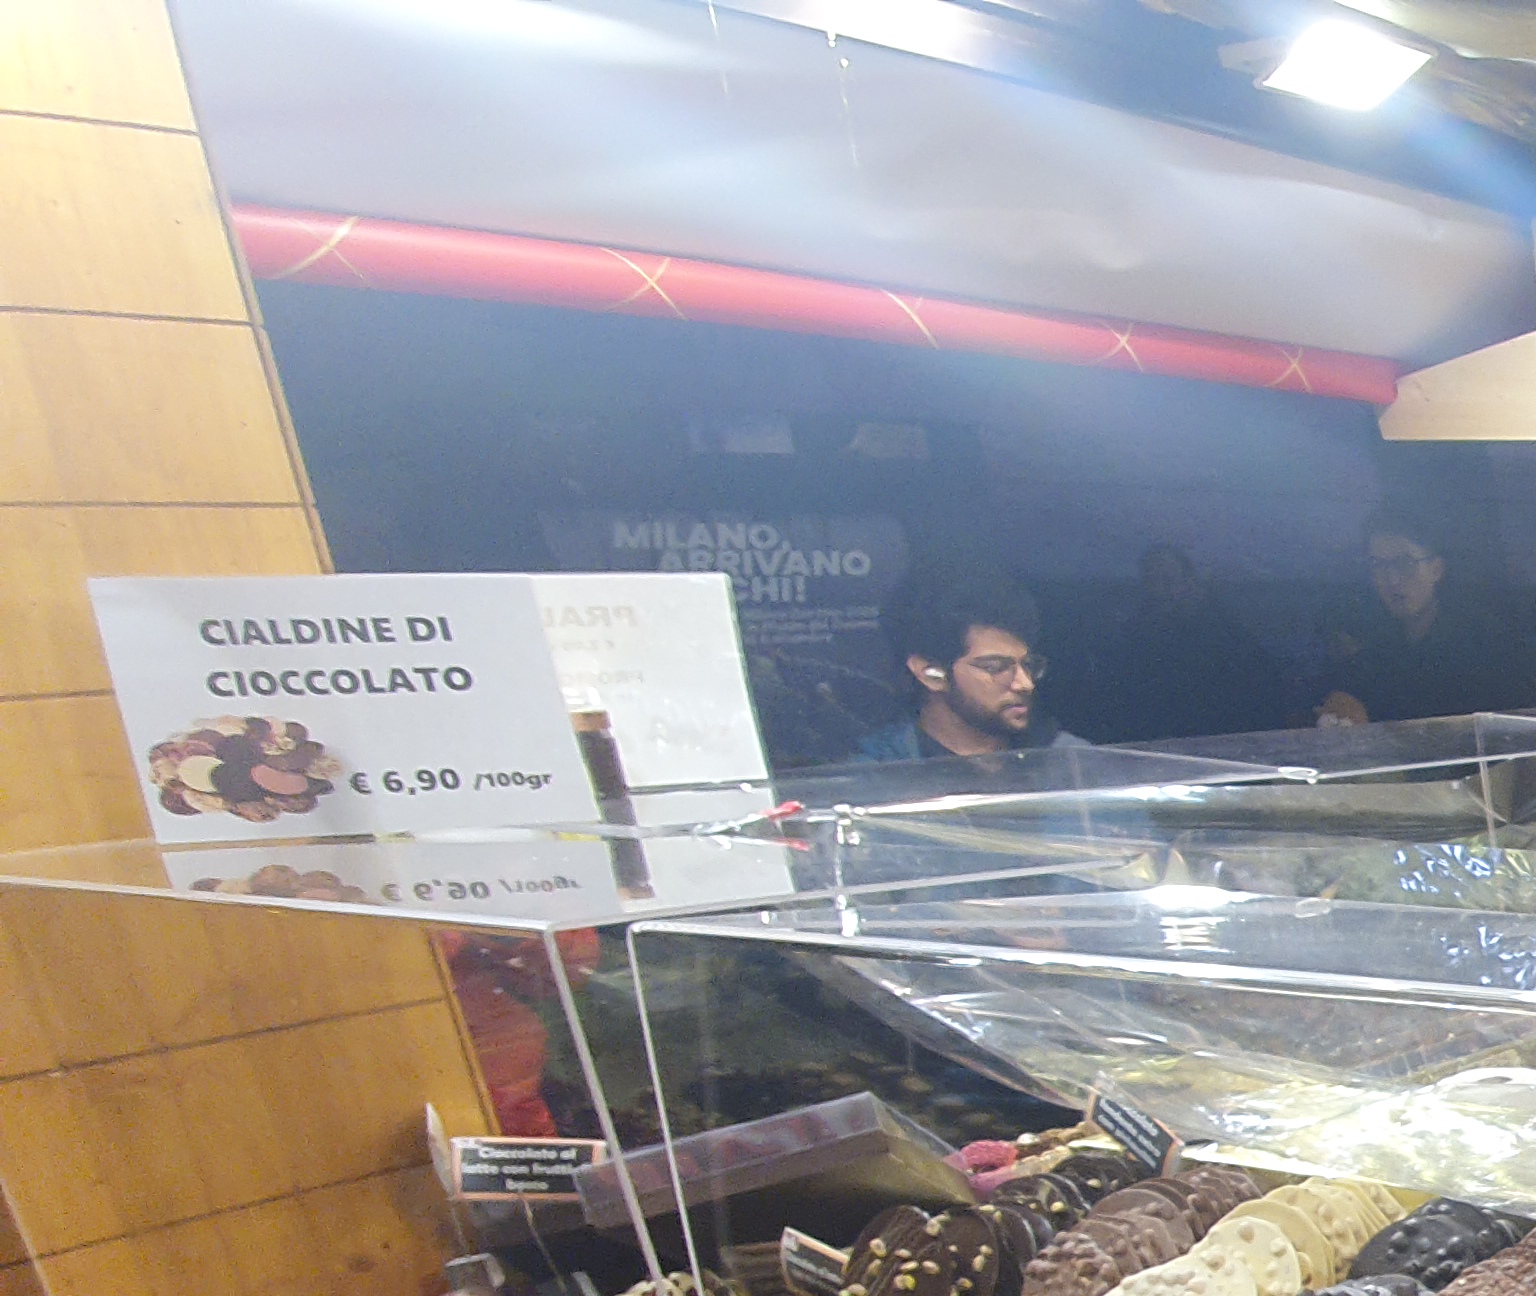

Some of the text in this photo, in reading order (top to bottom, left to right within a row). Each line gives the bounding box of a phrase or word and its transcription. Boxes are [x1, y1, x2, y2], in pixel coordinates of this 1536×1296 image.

[200, 616, 453, 646] CIALDINE DI
[206, 667, 473, 697] CIOCCOLATO
[350, 768, 552, 797] € 6,90 /100gr
